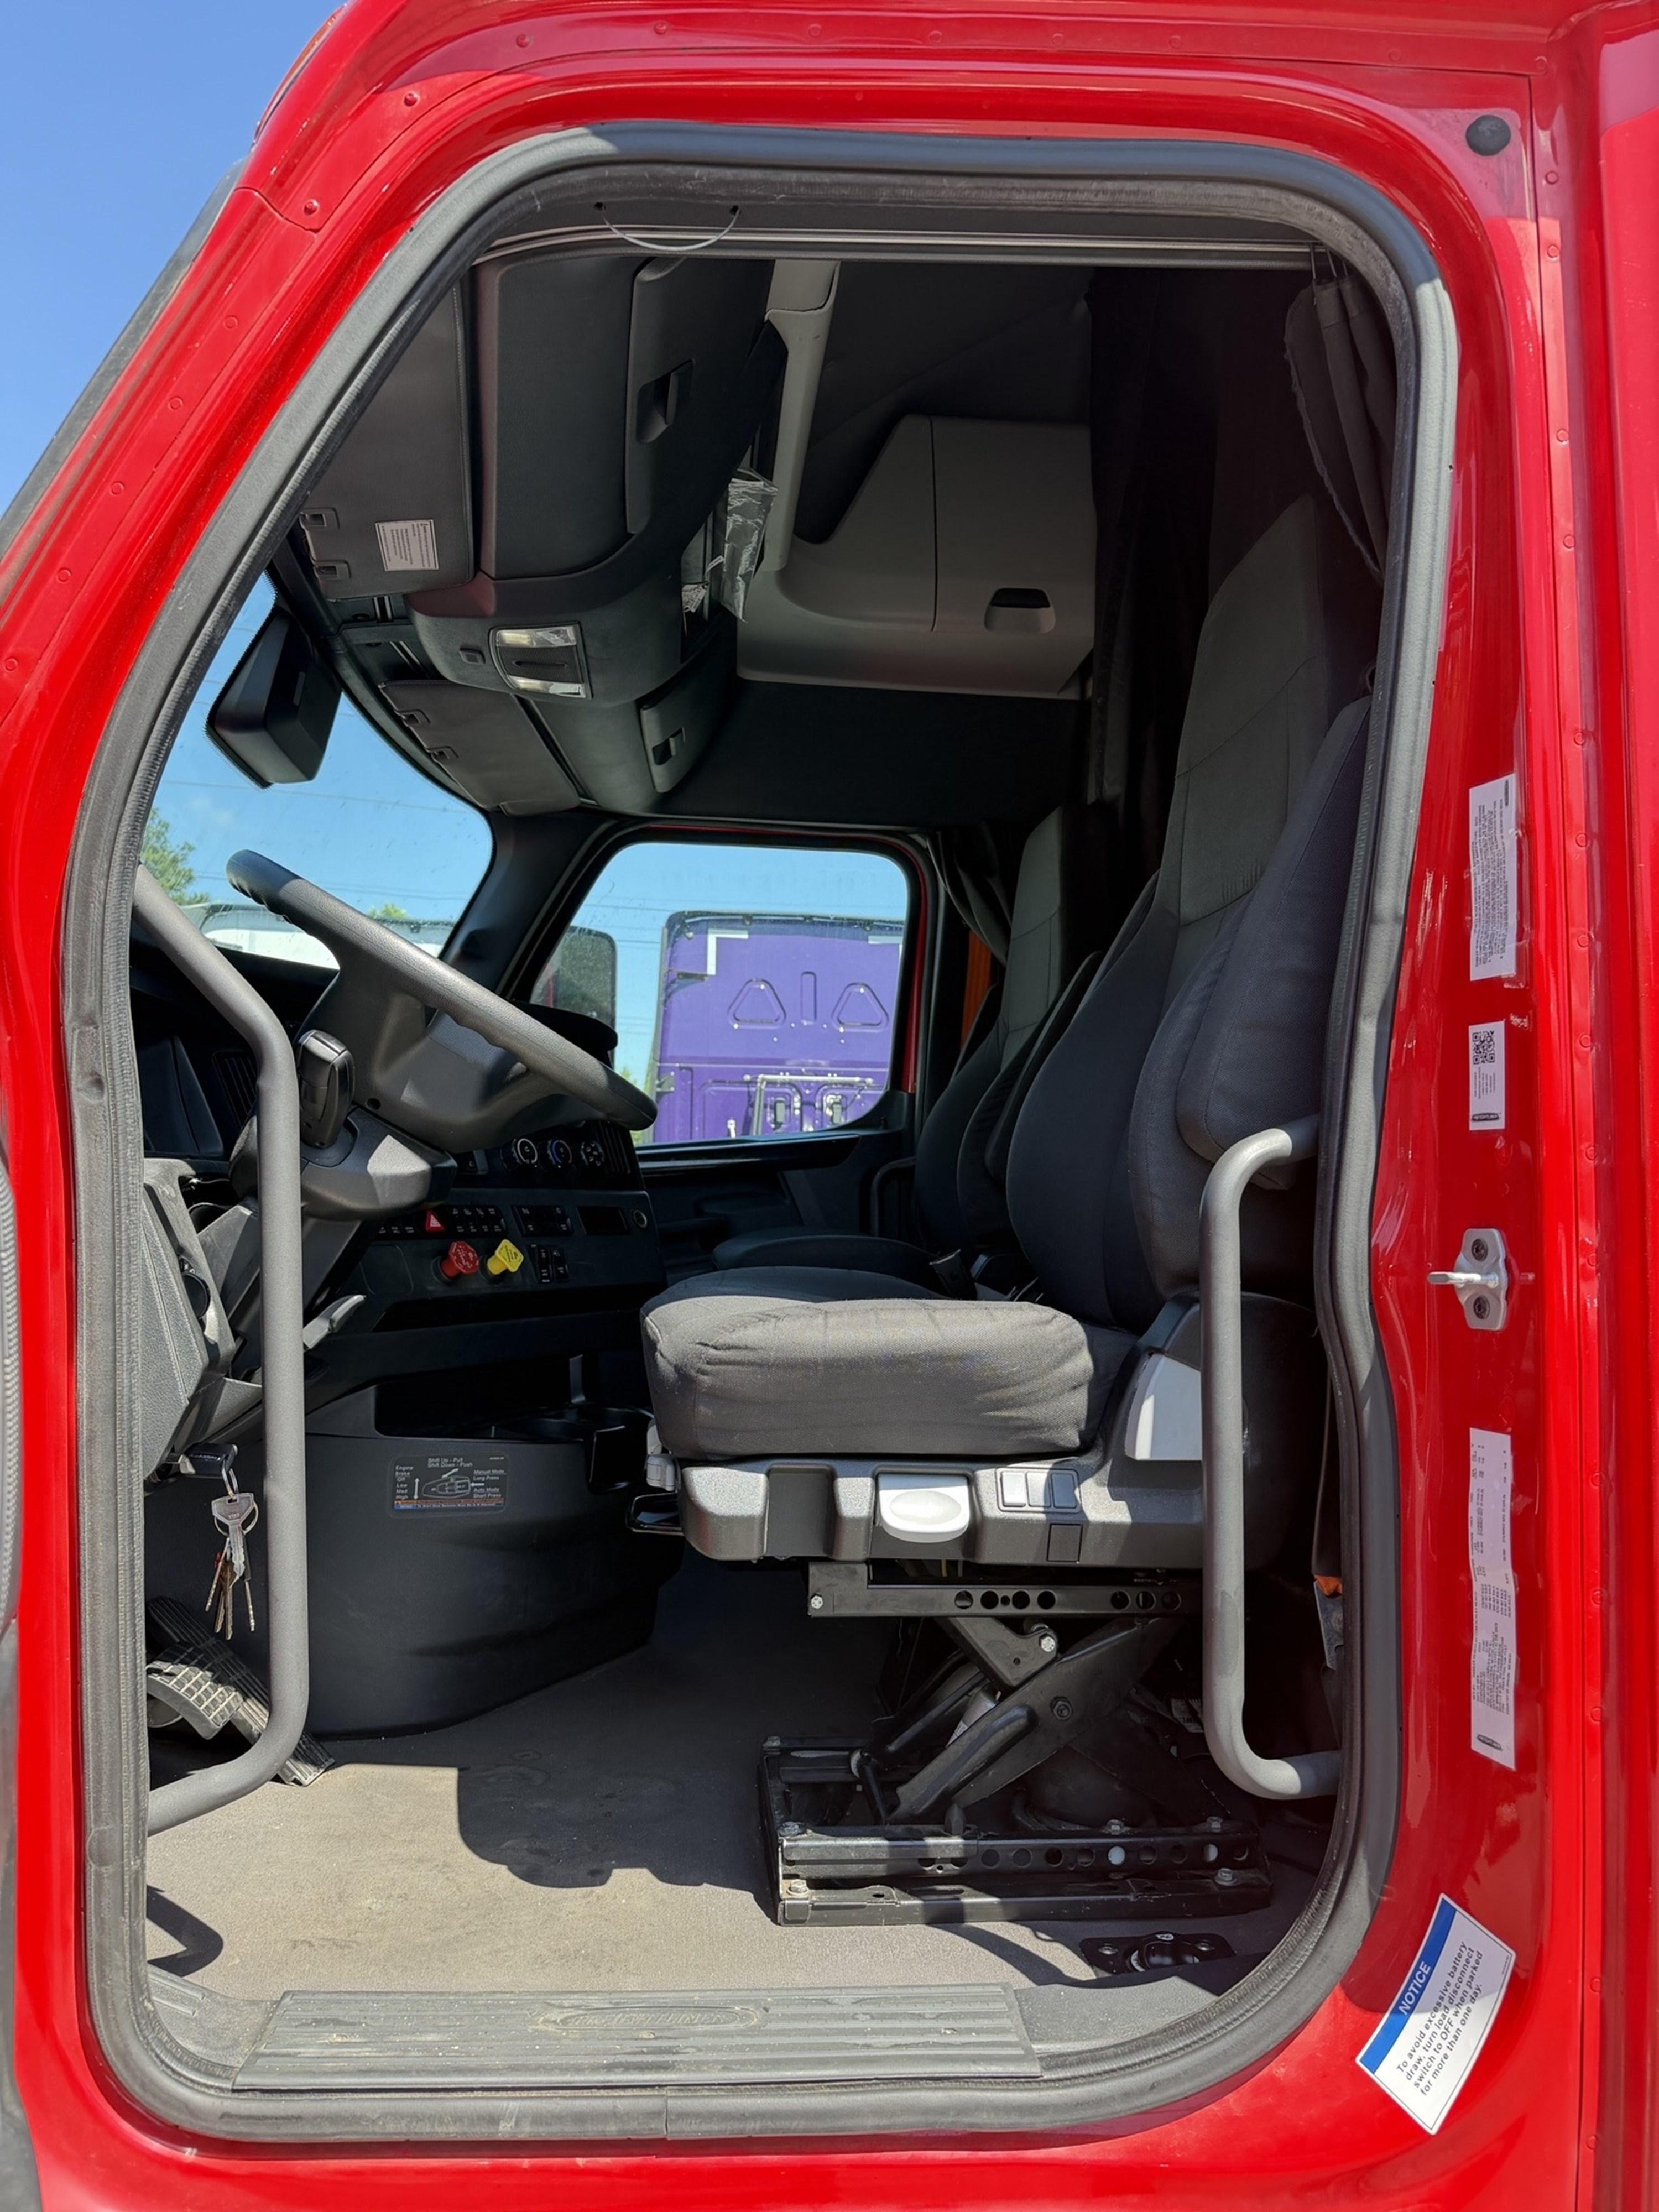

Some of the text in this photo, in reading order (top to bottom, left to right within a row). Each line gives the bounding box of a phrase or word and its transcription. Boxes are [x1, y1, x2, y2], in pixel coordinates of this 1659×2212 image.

[1396, 1941, 1467, 2073] To avoid excessive battery
[1399, 1961, 1431, 2015] NOTICE
[1406, 1947, 1474, 2080] draw, turn load disconnect
[1413, 1950, 1483, 2089] switch to OFF when parked
[1420, 1984, 1483, 2096] for more than one day.
